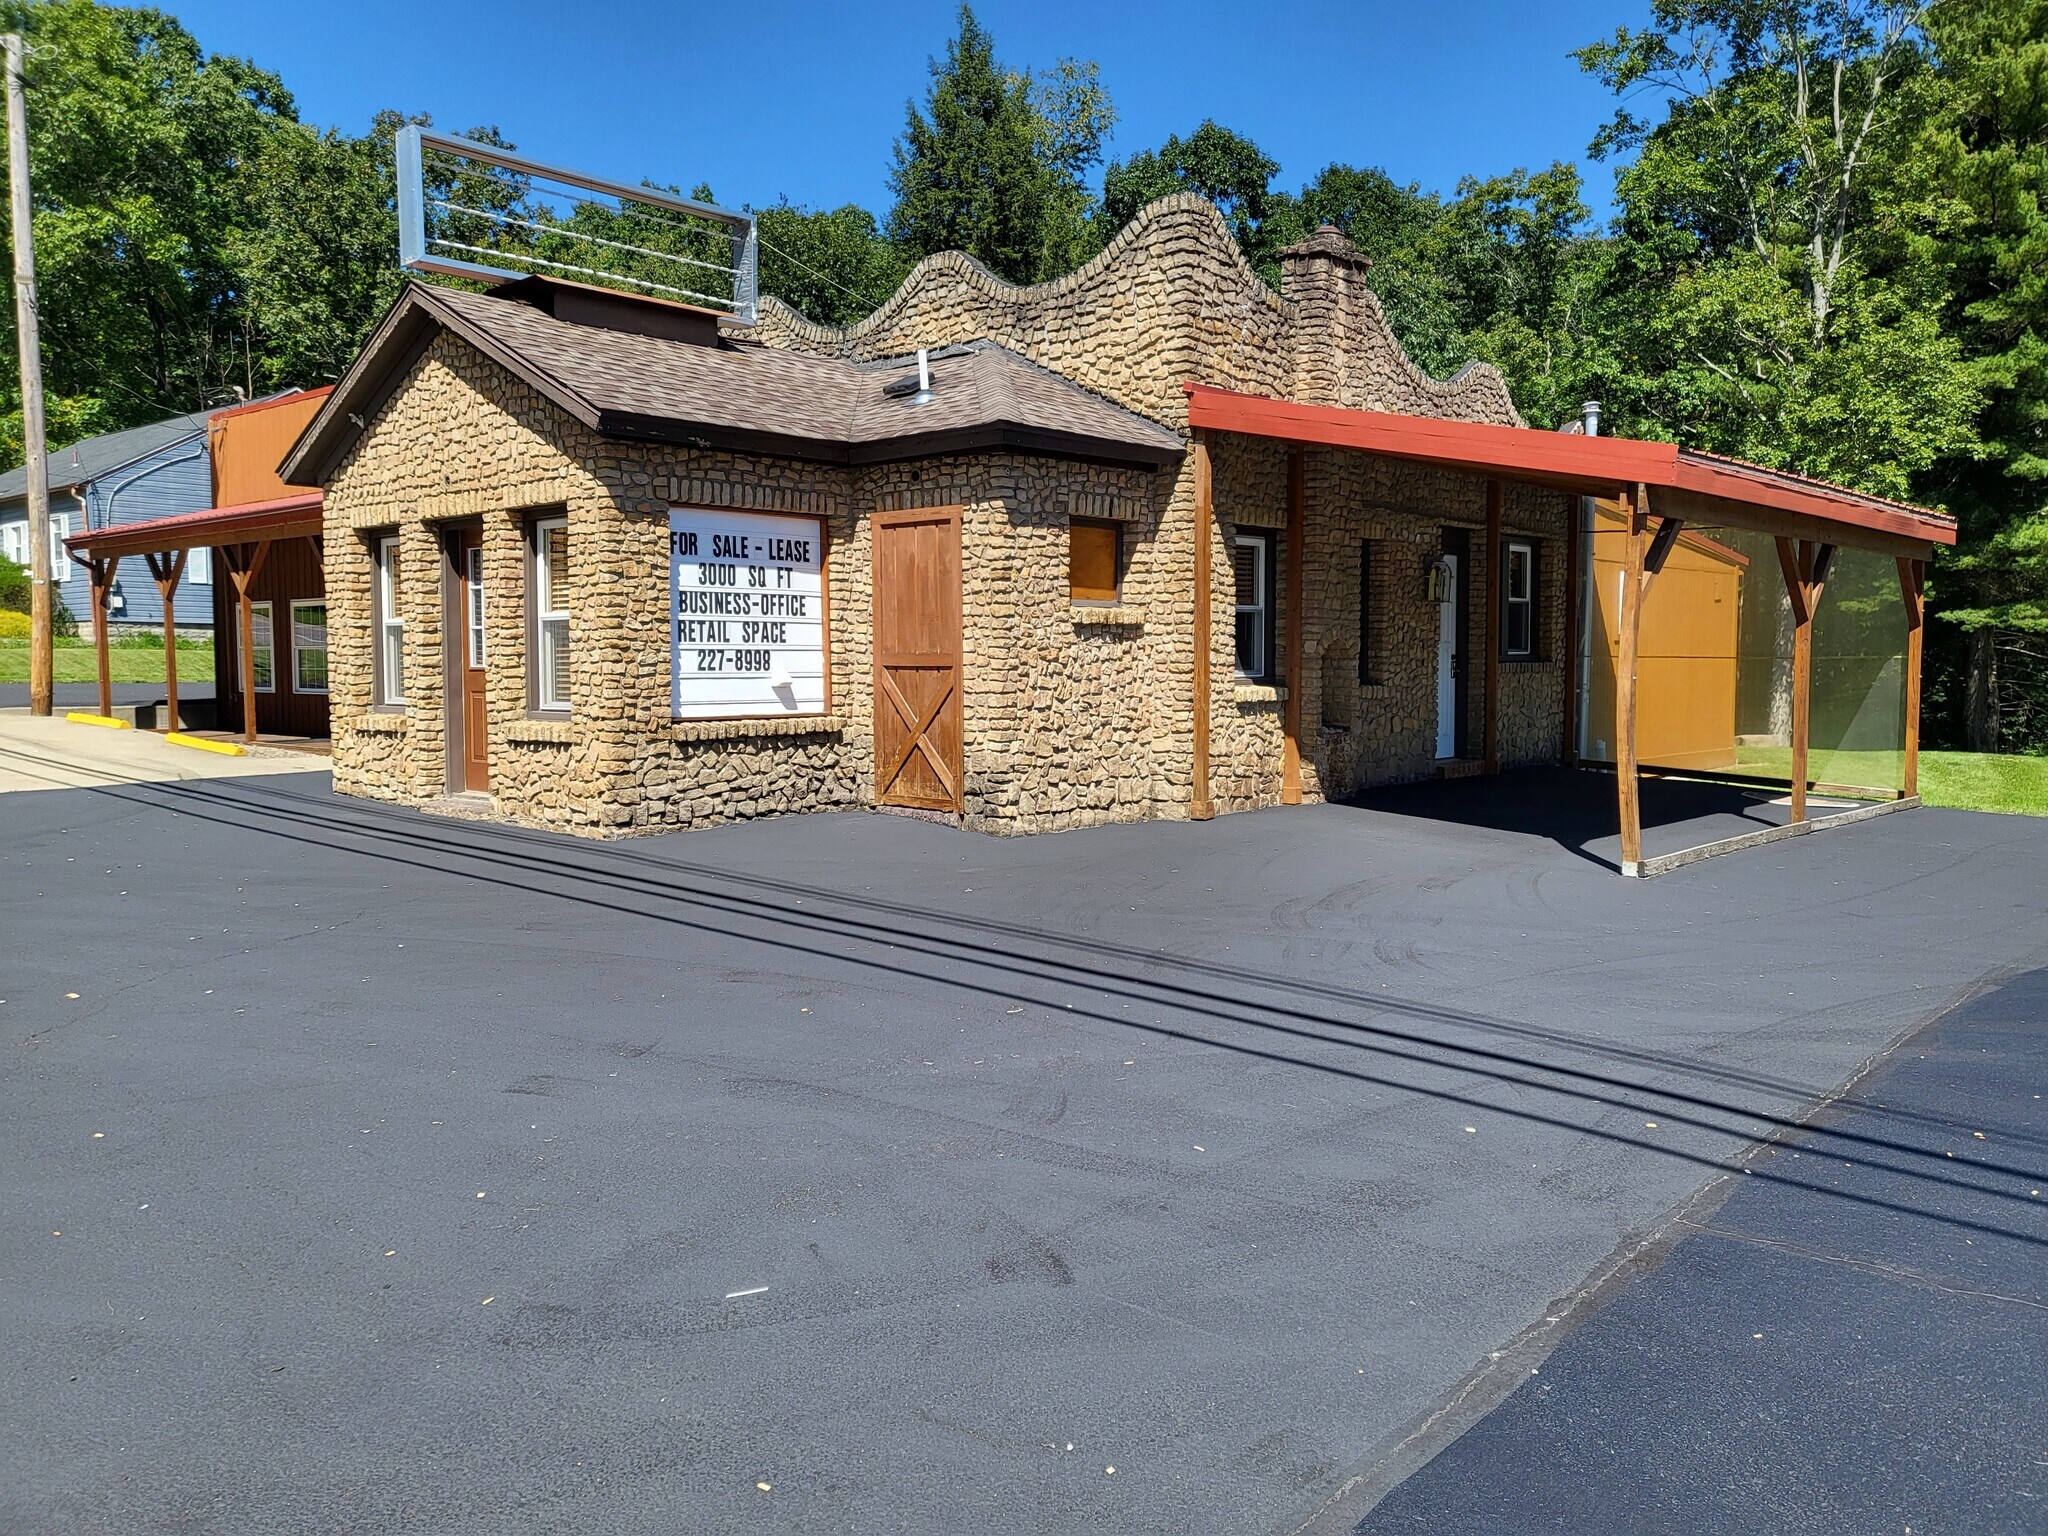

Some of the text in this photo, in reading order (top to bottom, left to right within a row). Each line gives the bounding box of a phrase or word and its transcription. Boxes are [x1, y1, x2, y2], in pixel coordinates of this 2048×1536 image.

[670, 531, 698, 556] FOR
[712, 534, 749, 559] SALE
[768, 538, 810, 563] LEASE
[698, 563, 793, 589] 3000 SQ FT
[679, 591, 807, 617] BUSINESS-OFFICE
[678, 620, 787, 644] RETAIL SPACE
[697, 649, 771, 672] 227-8998
